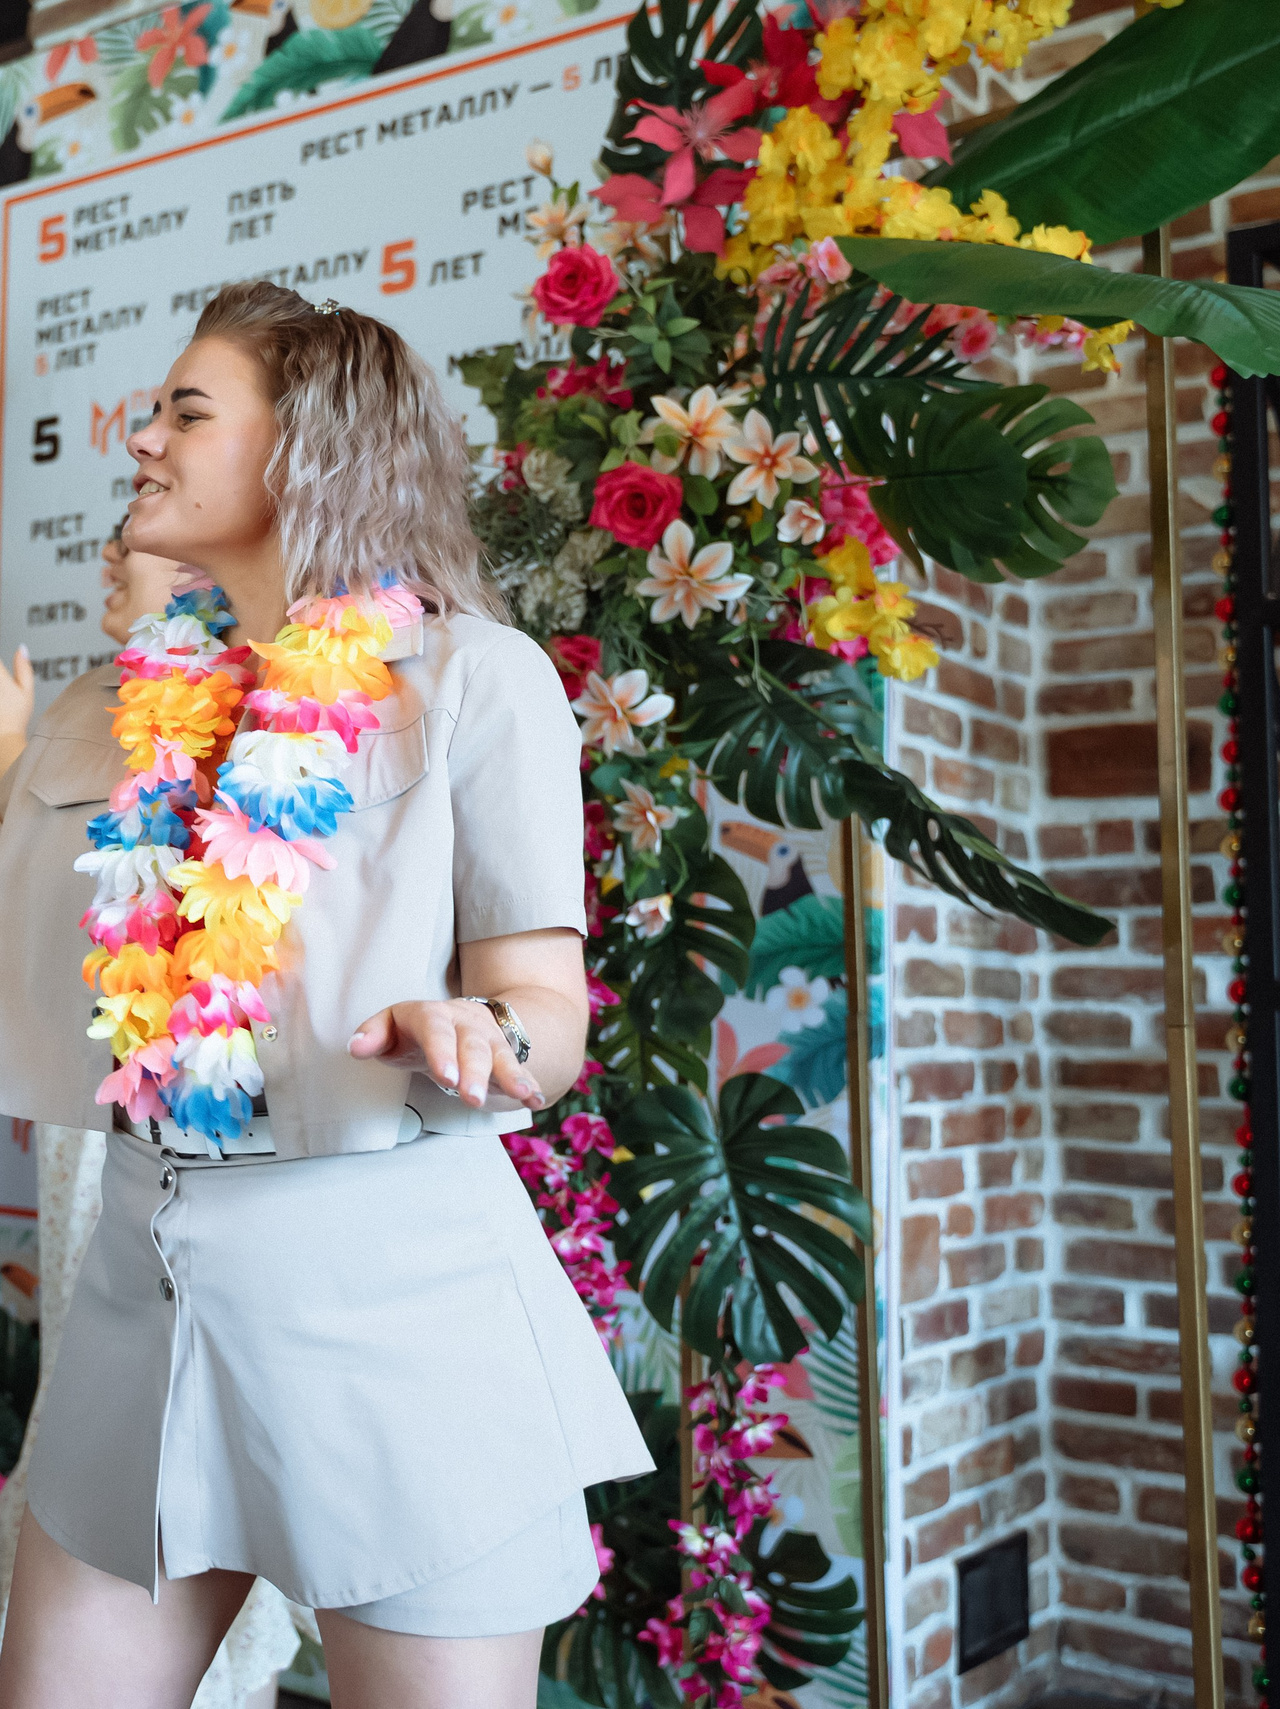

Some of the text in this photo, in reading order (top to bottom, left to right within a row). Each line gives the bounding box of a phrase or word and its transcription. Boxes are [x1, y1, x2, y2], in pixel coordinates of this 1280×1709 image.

[300, 127, 368, 166] РЕСТ
[376, 82, 520, 143] МЕТАЛЛУ
[73, 191, 132, 228] РЕСТ
[461, 175, 537, 215] РЕСТ
[37, 212, 68, 264] 5
[72, 205, 189, 257] МЕТАЛЛУ
[226, 210, 277, 245] ЛЕТ
[379, 238, 418, 295] 5
[428, 250, 486, 286] ЛЕТ
[36, 286, 92, 321] РЕСТ
[32, 414, 62, 465] 5
